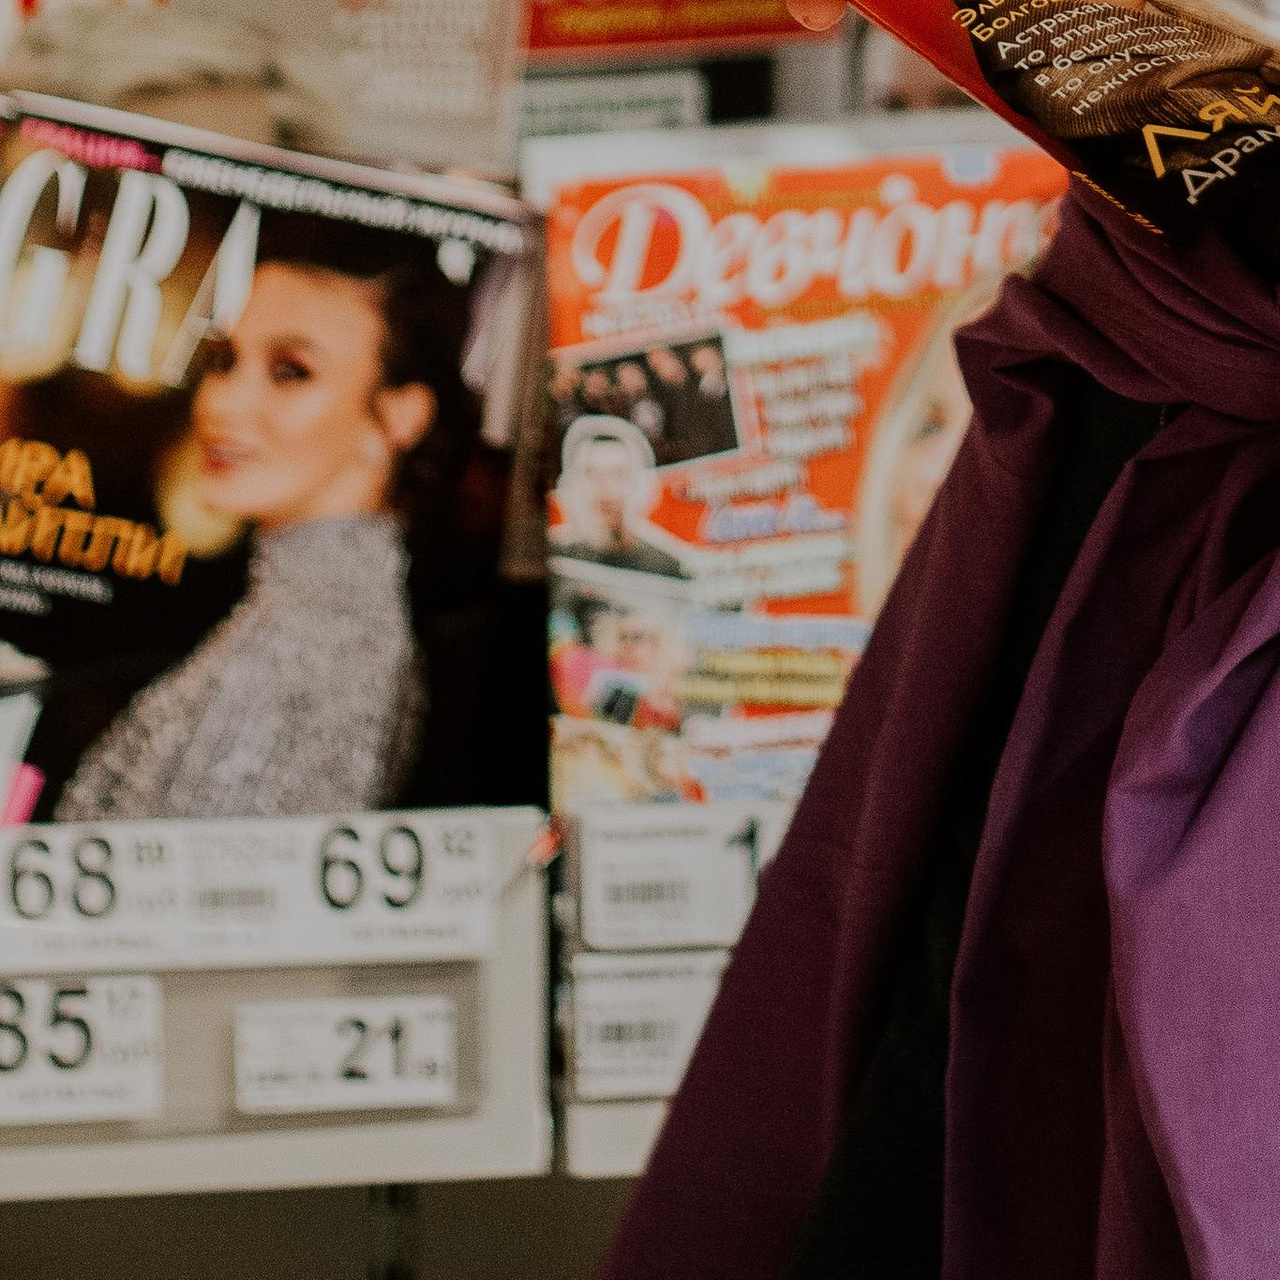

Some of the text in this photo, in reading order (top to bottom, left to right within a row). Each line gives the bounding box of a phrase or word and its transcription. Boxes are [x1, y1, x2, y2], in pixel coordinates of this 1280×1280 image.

[996, 1, 1115, 61] Астрахан
[1014, 13, 1140, 71] то впадал
[1033, 73, 1052, 88] в
[1052, 38, 1204, 100] то окутывал
[1071, 49, 1213, 117] нежностью
[8, 837, 117, 920] 68
[320, 825, 425, 912] 69
[336, 1016, 408, 1081] 21
